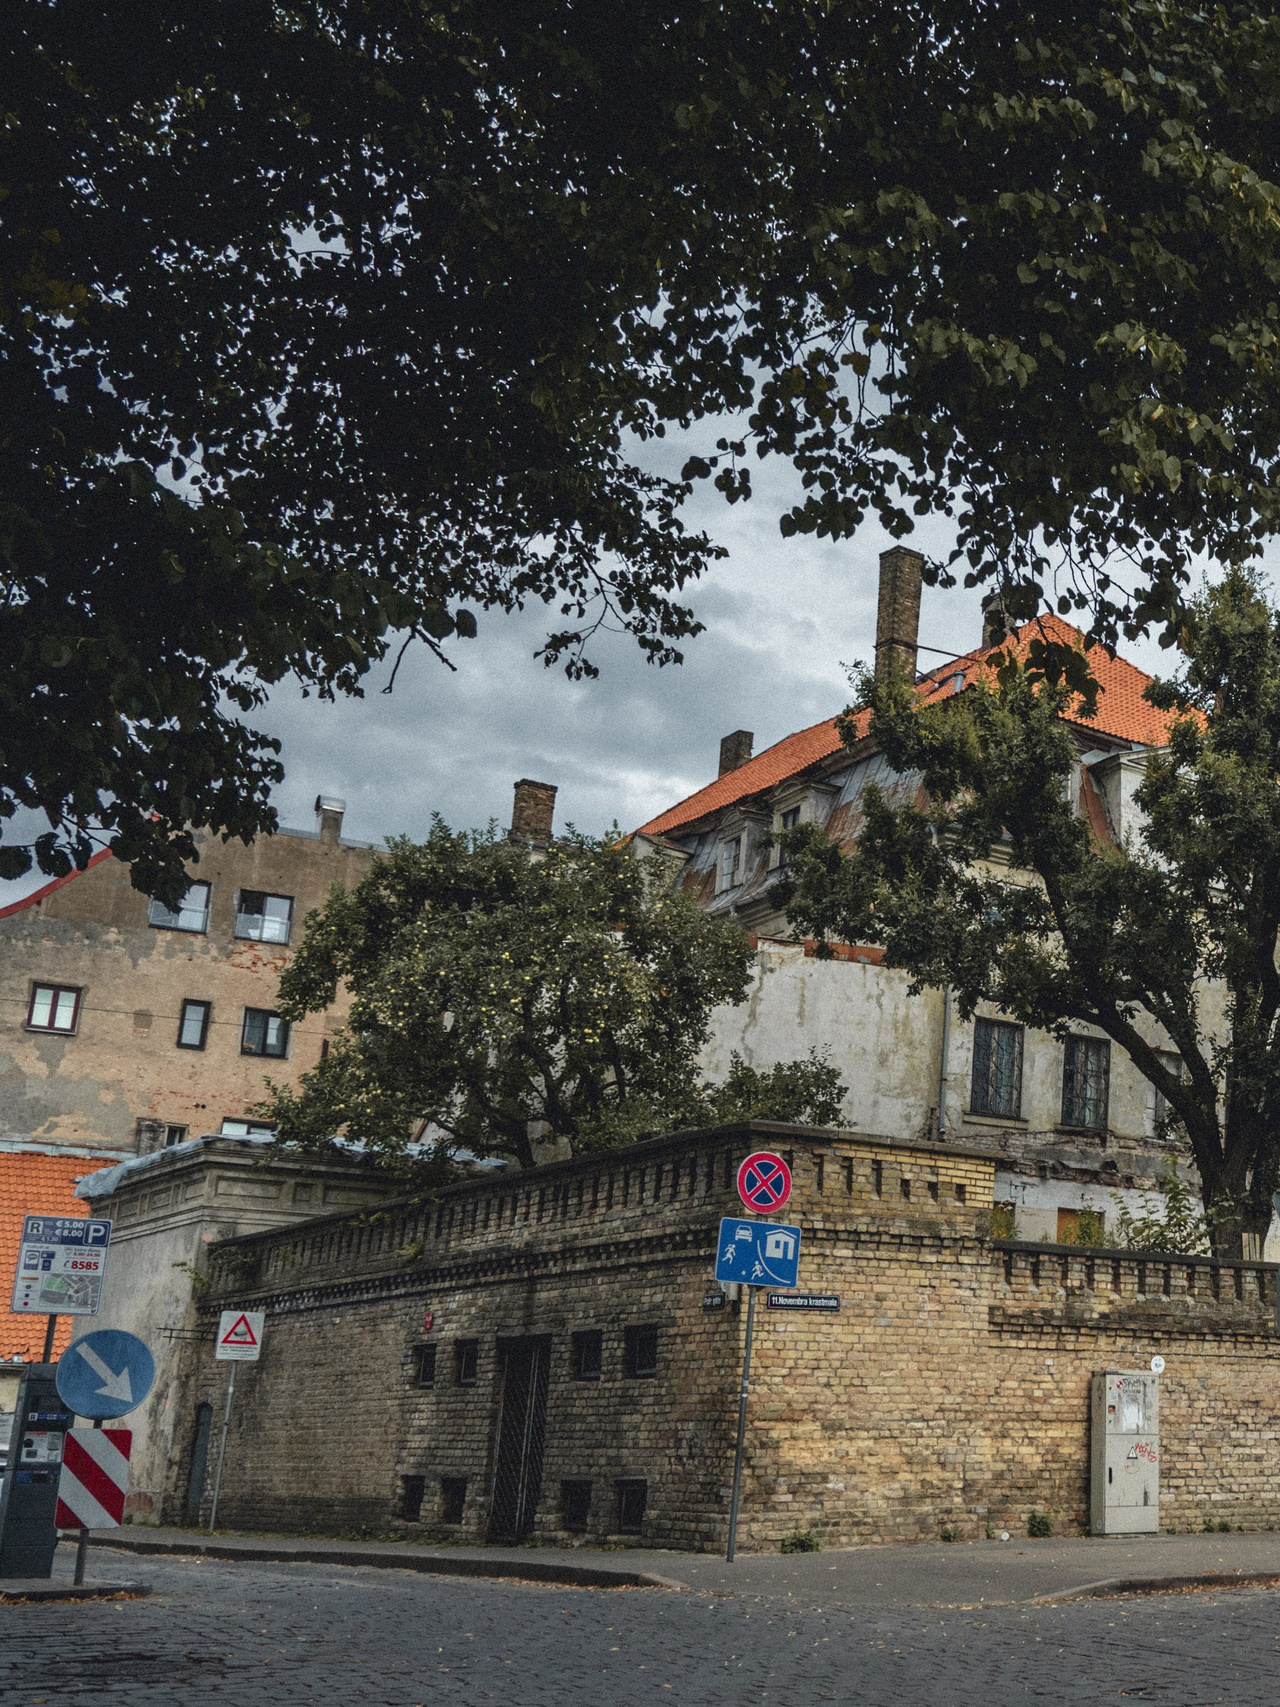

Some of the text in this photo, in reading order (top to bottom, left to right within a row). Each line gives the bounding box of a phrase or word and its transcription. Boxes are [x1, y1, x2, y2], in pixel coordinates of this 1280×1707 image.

[30, 1221, 41, 1233] R
[87, 1224, 105, 1244] P
[71, 1260, 99, 1271] 8585
